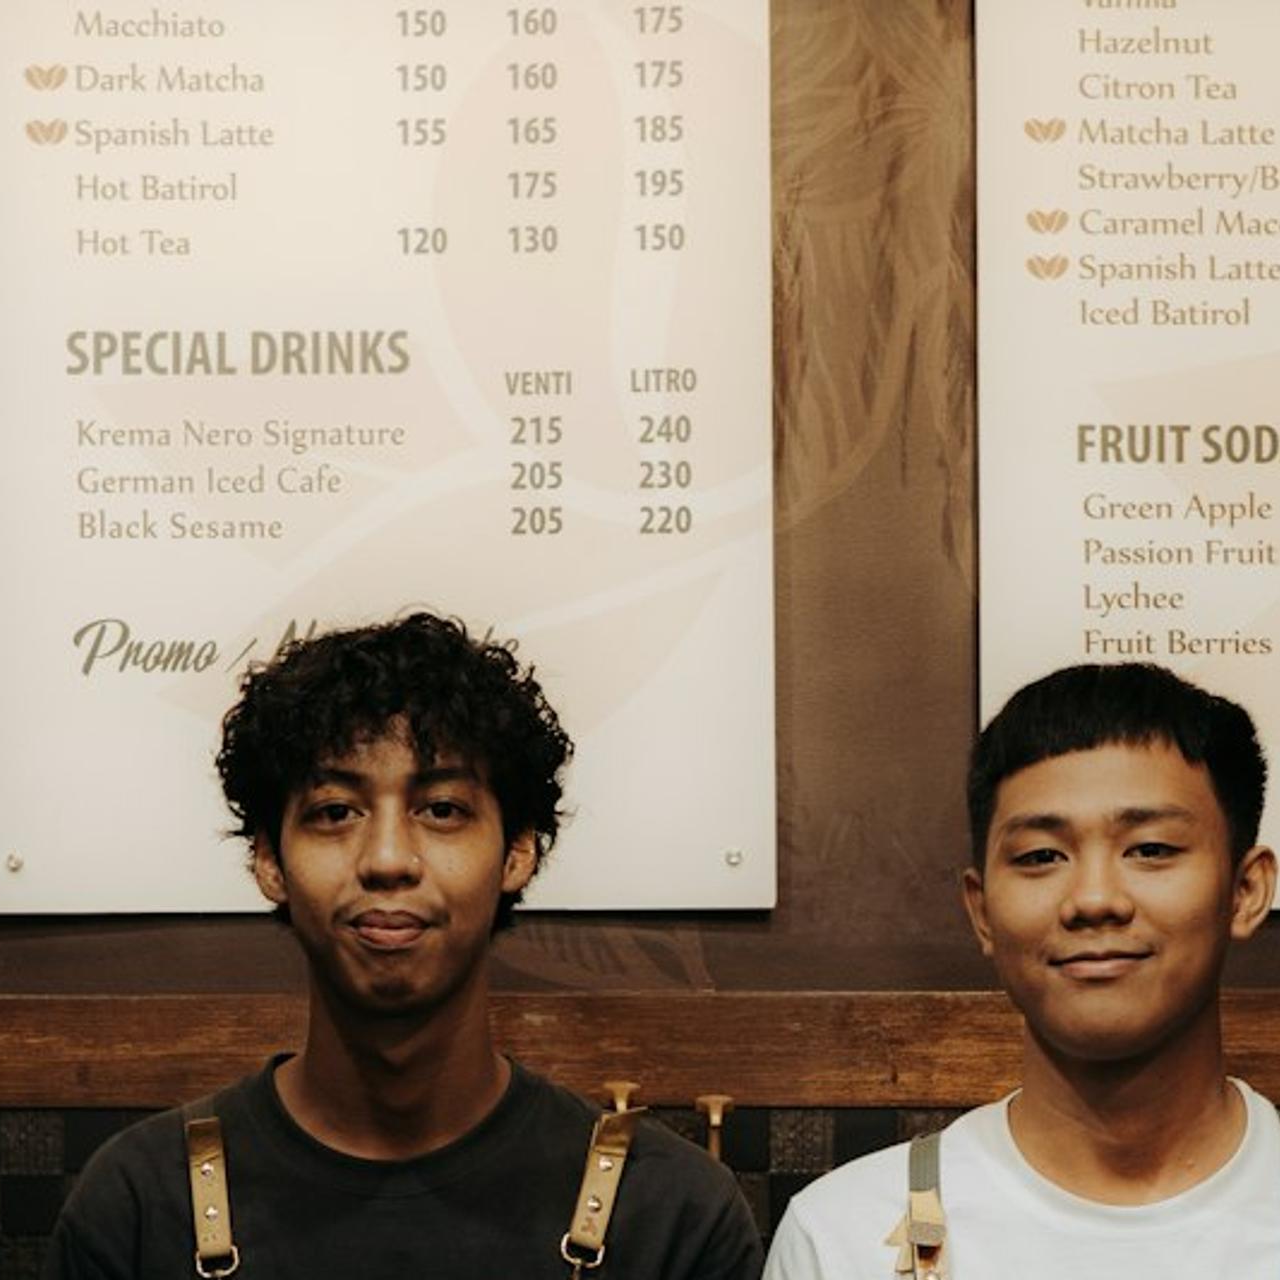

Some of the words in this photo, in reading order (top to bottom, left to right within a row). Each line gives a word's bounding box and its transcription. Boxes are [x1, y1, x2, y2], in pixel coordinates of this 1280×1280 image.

[1078, 26, 1213, 55] Hazelnut
[75, 62, 146, 92] Dark
[157, 62, 264, 92] Matcha
[396, 64, 447, 92] 150
[507, 62, 557, 90] 160
[634, 60, 683, 88] 175
[1079, 74, 1175, 100] Citron
[1186, 75, 1237, 100] Tea
[75, 117, 190, 154] Spanish
[201, 120, 274, 146] Latte
[397, 118, 447, 146] 155
[508, 117, 557, 144] 165
[634, 115, 683, 143] 185
[1079, 116, 1188, 145] Matcha
[1201, 120, 1275, 145] Latte
[1079, 206, 1204, 236] Caramel
[1079, 252, 1196, 288] Spanish
[1081, 297, 1139, 325] Iced
[1152, 297, 1250, 325] Batirol
[66, 331, 237, 375] SPECIAL
[251, 330, 410, 375] DRINKS
[505, 371, 572, 396] VENTI
[631, 368, 697, 393] LITRO
[77, 420, 171, 447] Krema
[183, 420, 252, 447] Nero
[264, 420, 405, 455] Signature
[511, 416, 562, 445] 215
[638, 415, 691, 443] 240
[1078, 425, 1191, 464] FRUIT
[77, 467, 194, 494] German
[208, 464, 264, 493] Iced
[277, 463, 341, 493] Cafe
[511, 461, 562, 490] 205
[639, 461, 692, 489] 230
[78, 509, 158, 539] Black
[170, 512, 282, 539] Sesame
[511, 507, 562, 535] 205
[640, 506, 692, 534] 220
[1084, 494, 1172, 520] Green
[1184, 491, 1272, 528] Apple
[1084, 539, 1193, 564] Passion
[1206, 540, 1276, 565] Fruit
[1084, 581, 1184, 618] Lychee
[73, 619, 220, 676] Promo
[1085, 630, 1155, 654] Fruit
[1168, 630, 1272, 654] Berries
